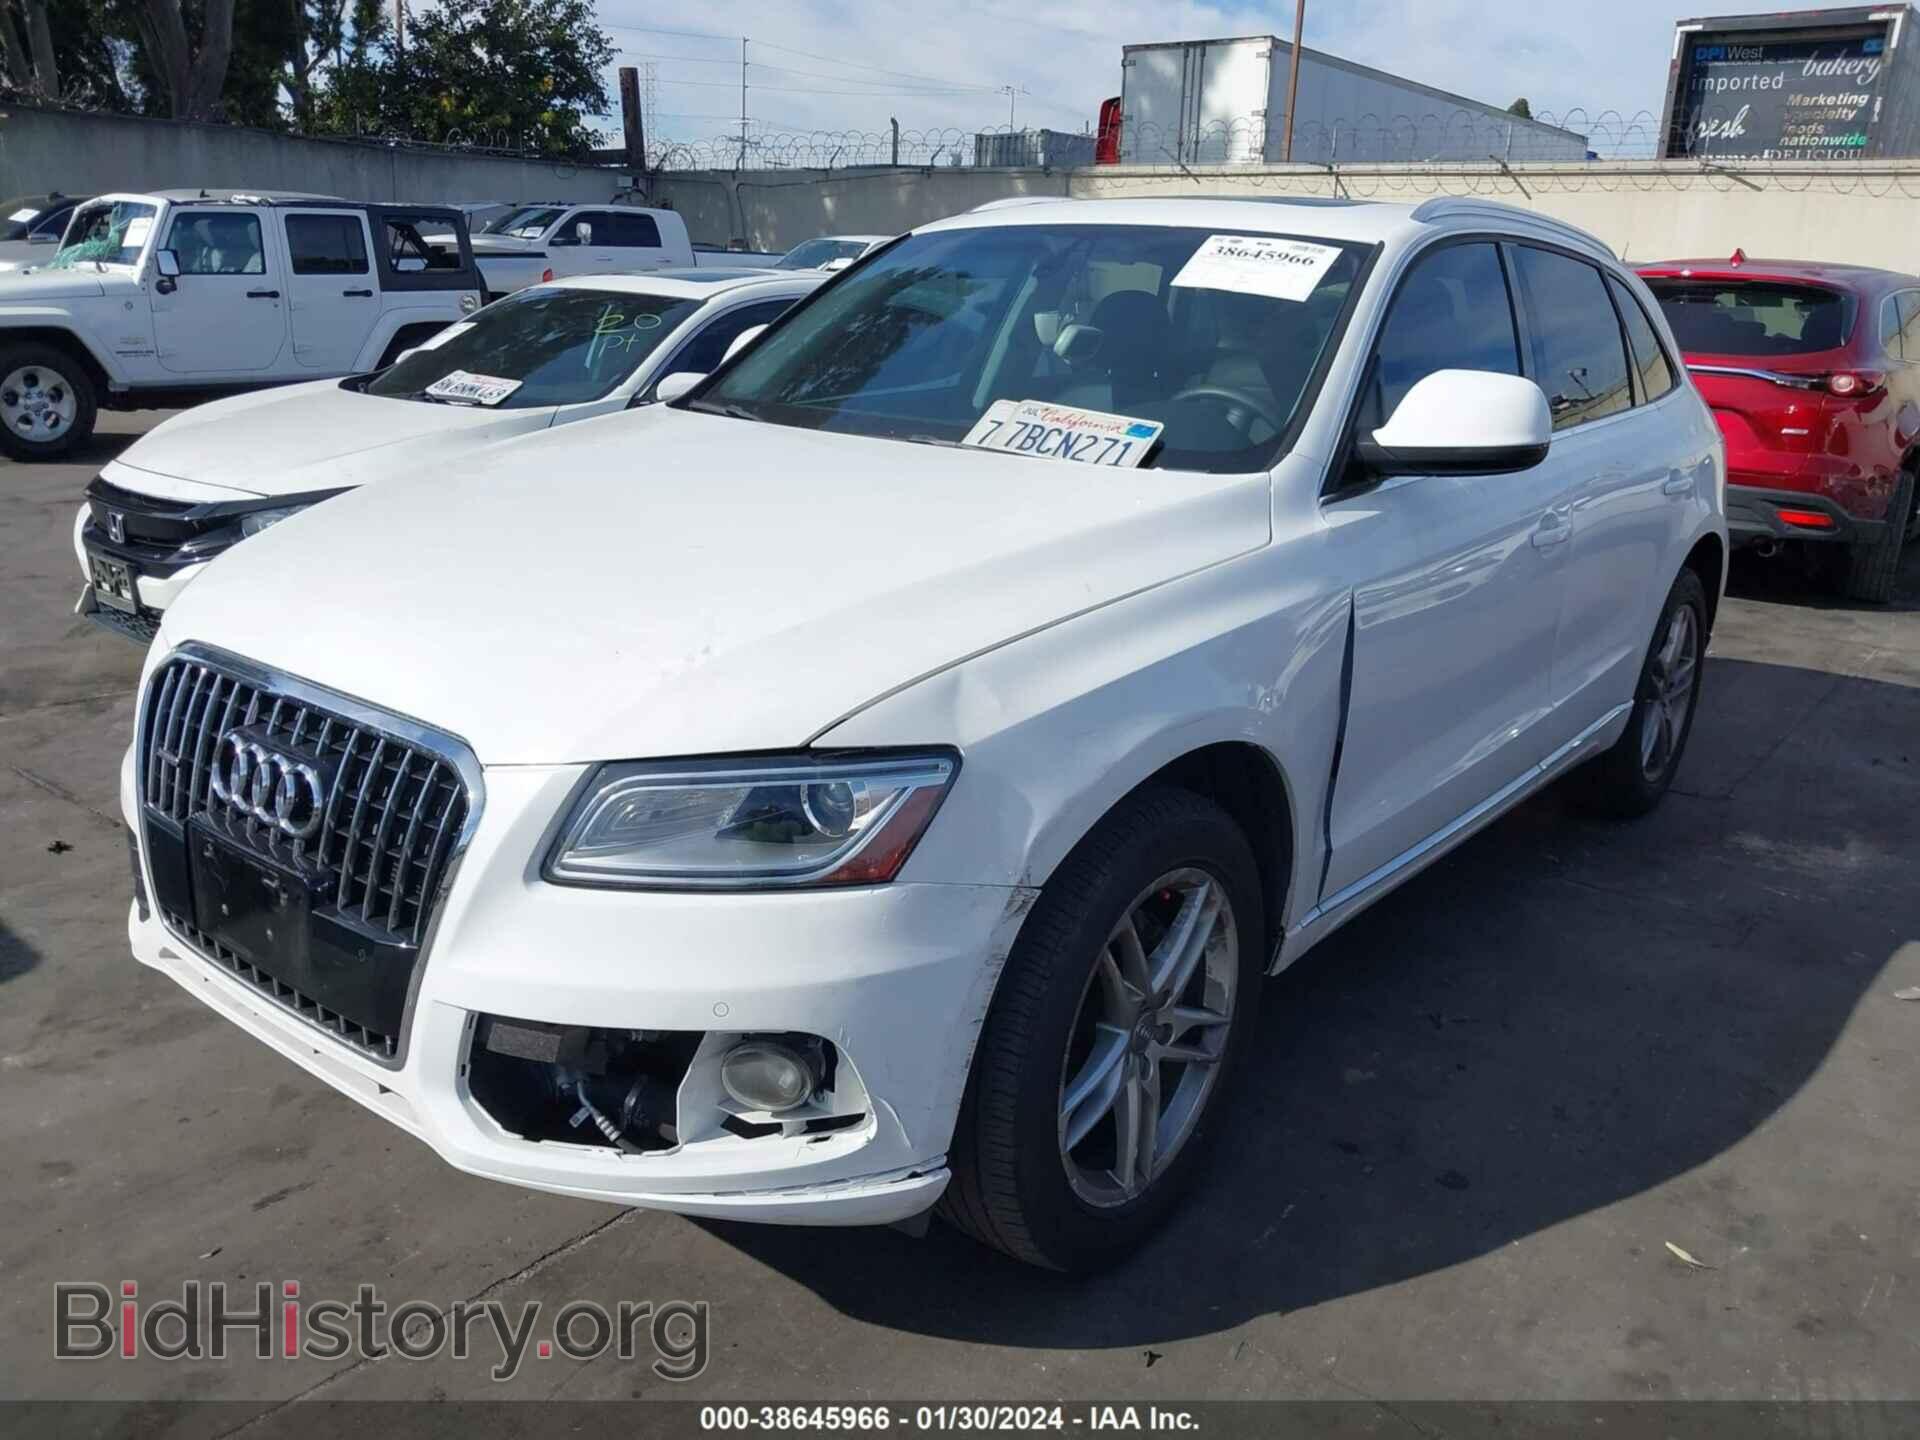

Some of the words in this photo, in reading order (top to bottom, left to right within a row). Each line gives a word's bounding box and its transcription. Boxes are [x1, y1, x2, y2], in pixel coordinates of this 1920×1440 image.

[1727, 46, 1764, 60] West
[1801, 48, 1882, 86] bakery
[1691, 71, 1785, 94] imported
[1786, 93, 1869, 108] Marketing
[1779, 132, 1867, 146] nationwide
[1217, 246, 1315, 266] 38645966
[1040, 408, 1123, 434] California
[1004, 420, 1134, 467] 7BCN271
